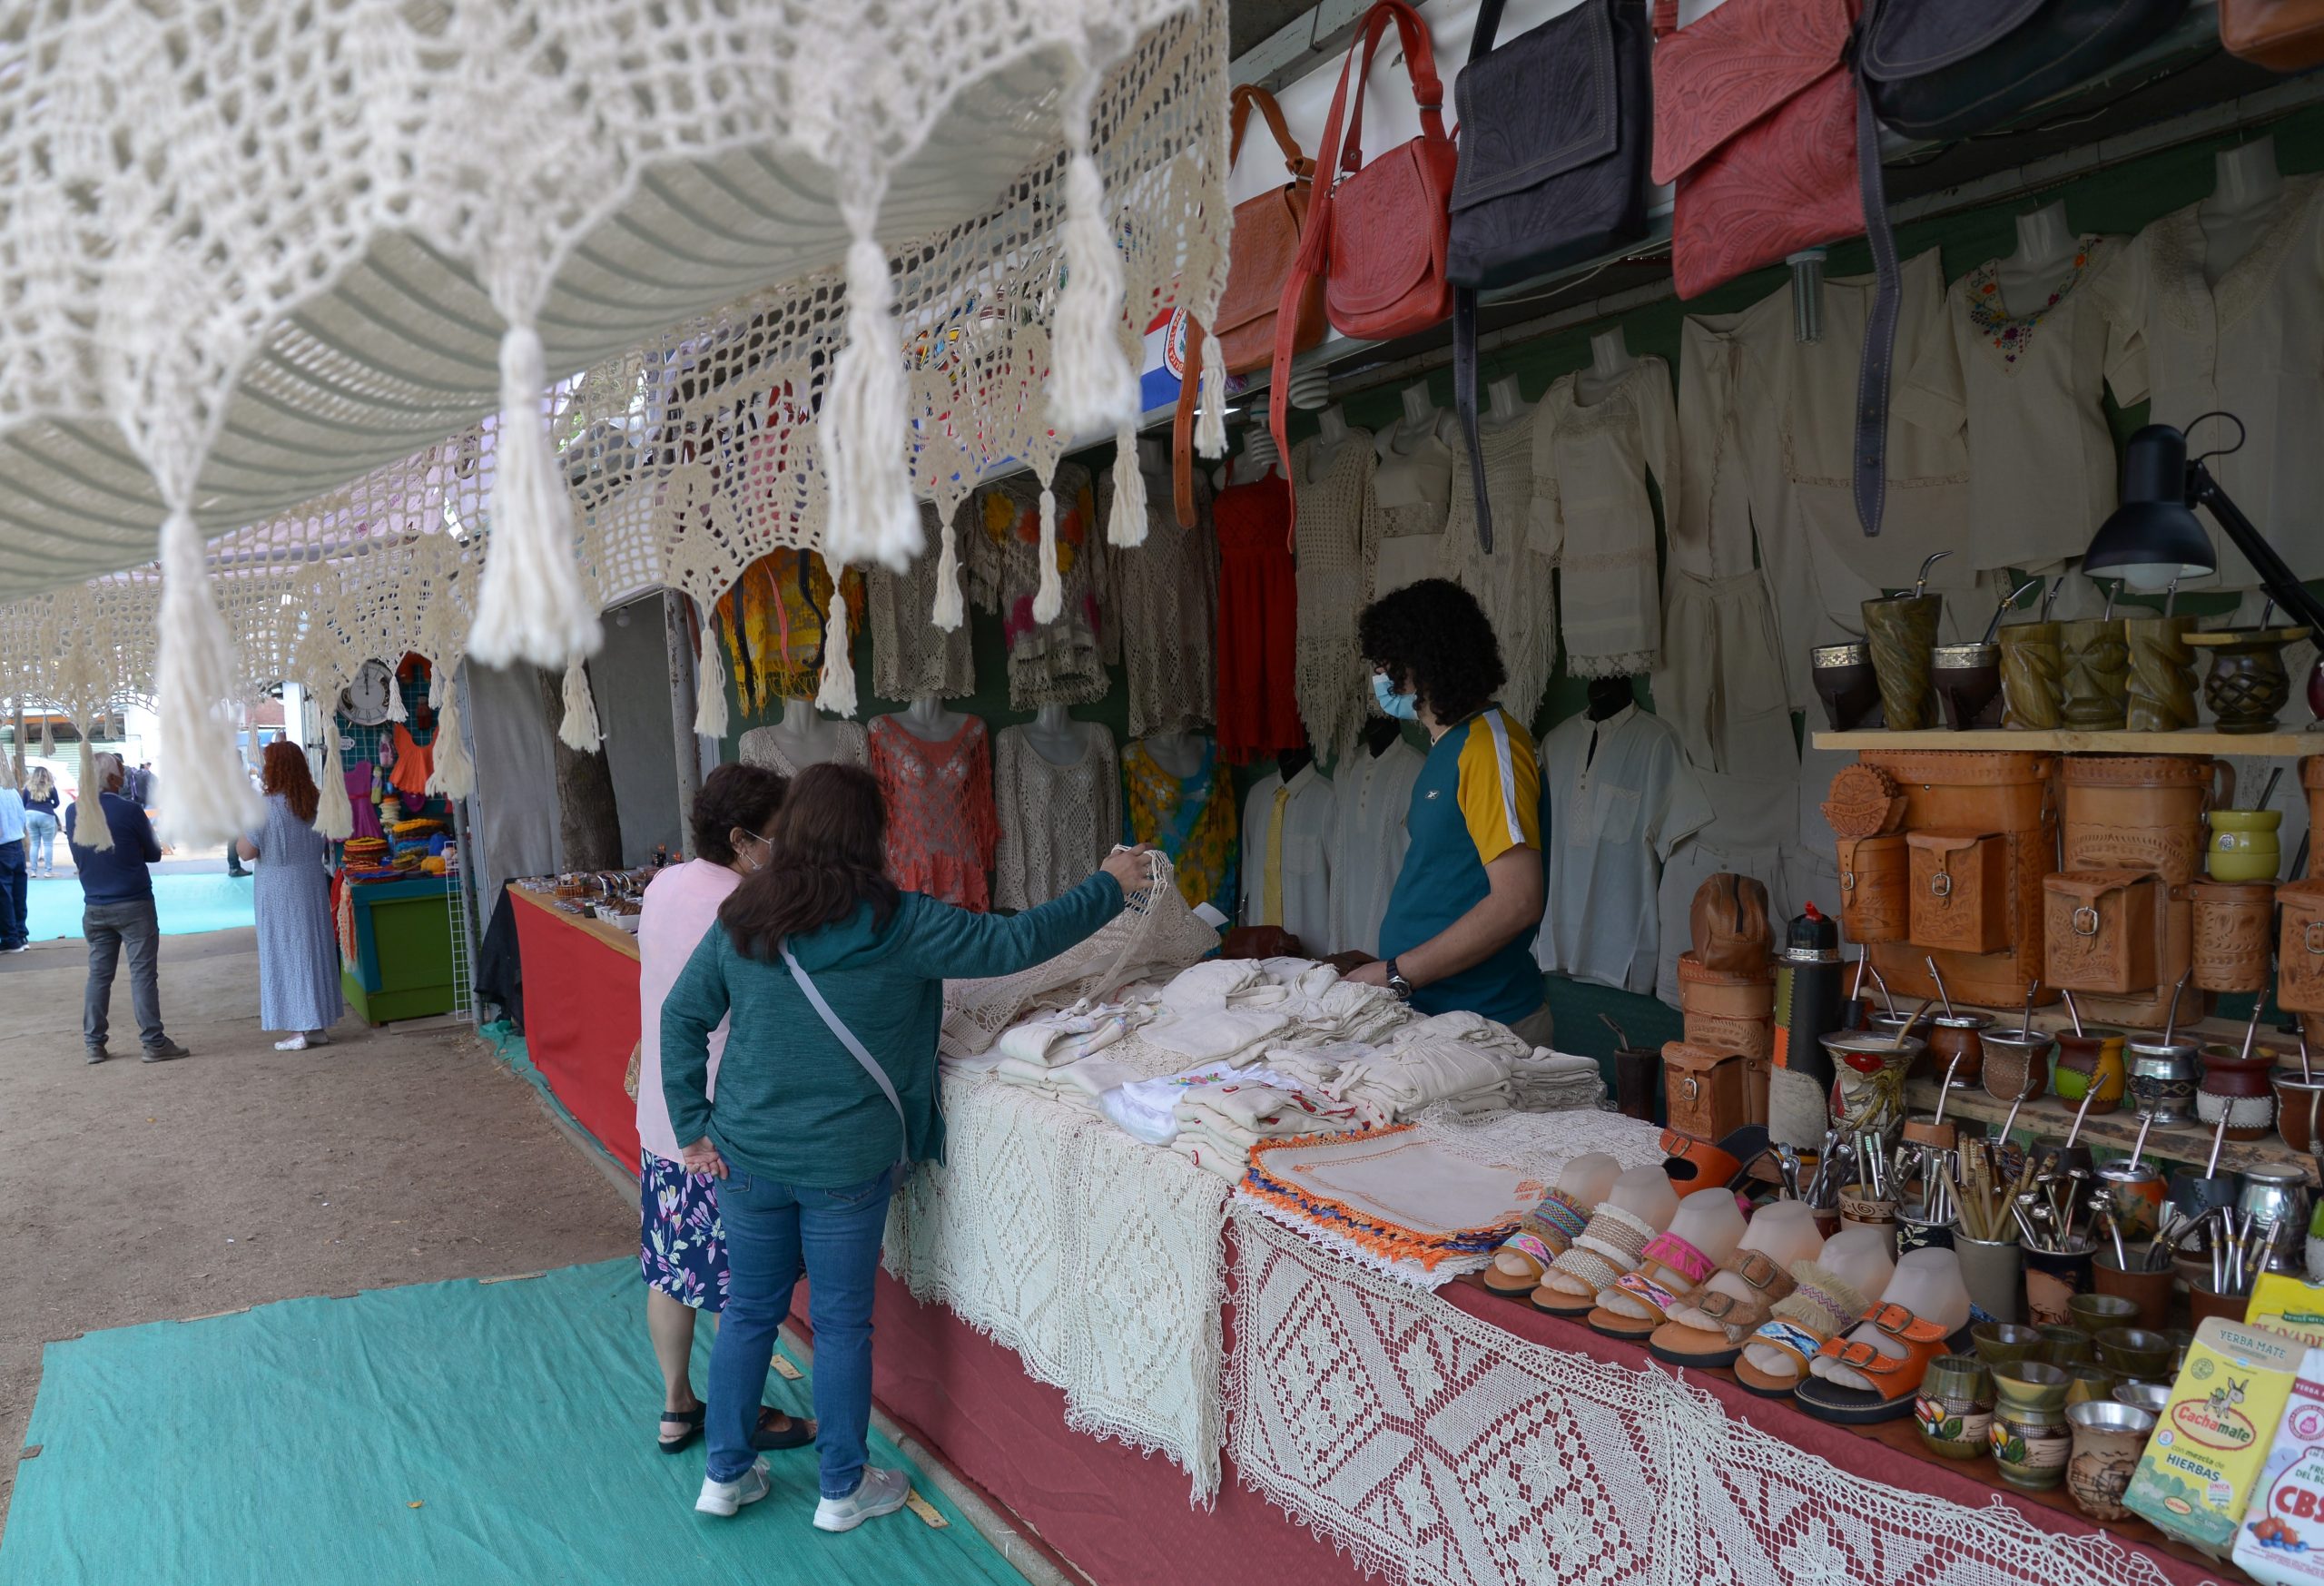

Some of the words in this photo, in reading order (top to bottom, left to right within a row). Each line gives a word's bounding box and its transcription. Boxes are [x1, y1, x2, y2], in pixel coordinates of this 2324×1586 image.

[2220, 1329, 2254, 1348] YERBA
[2256, 1341, 2287, 1360] MATE
[2295, 1382, 2319, 1397] YERBA
[2178, 1405, 2251, 1443] Cachamate
[2171, 1444, 2186, 1454] con
[2184, 1450, 2214, 1465] mezcla
[2166, 1453, 2221, 1483] HIERBAS
[2295, 1468, 2311, 1482] DEL
